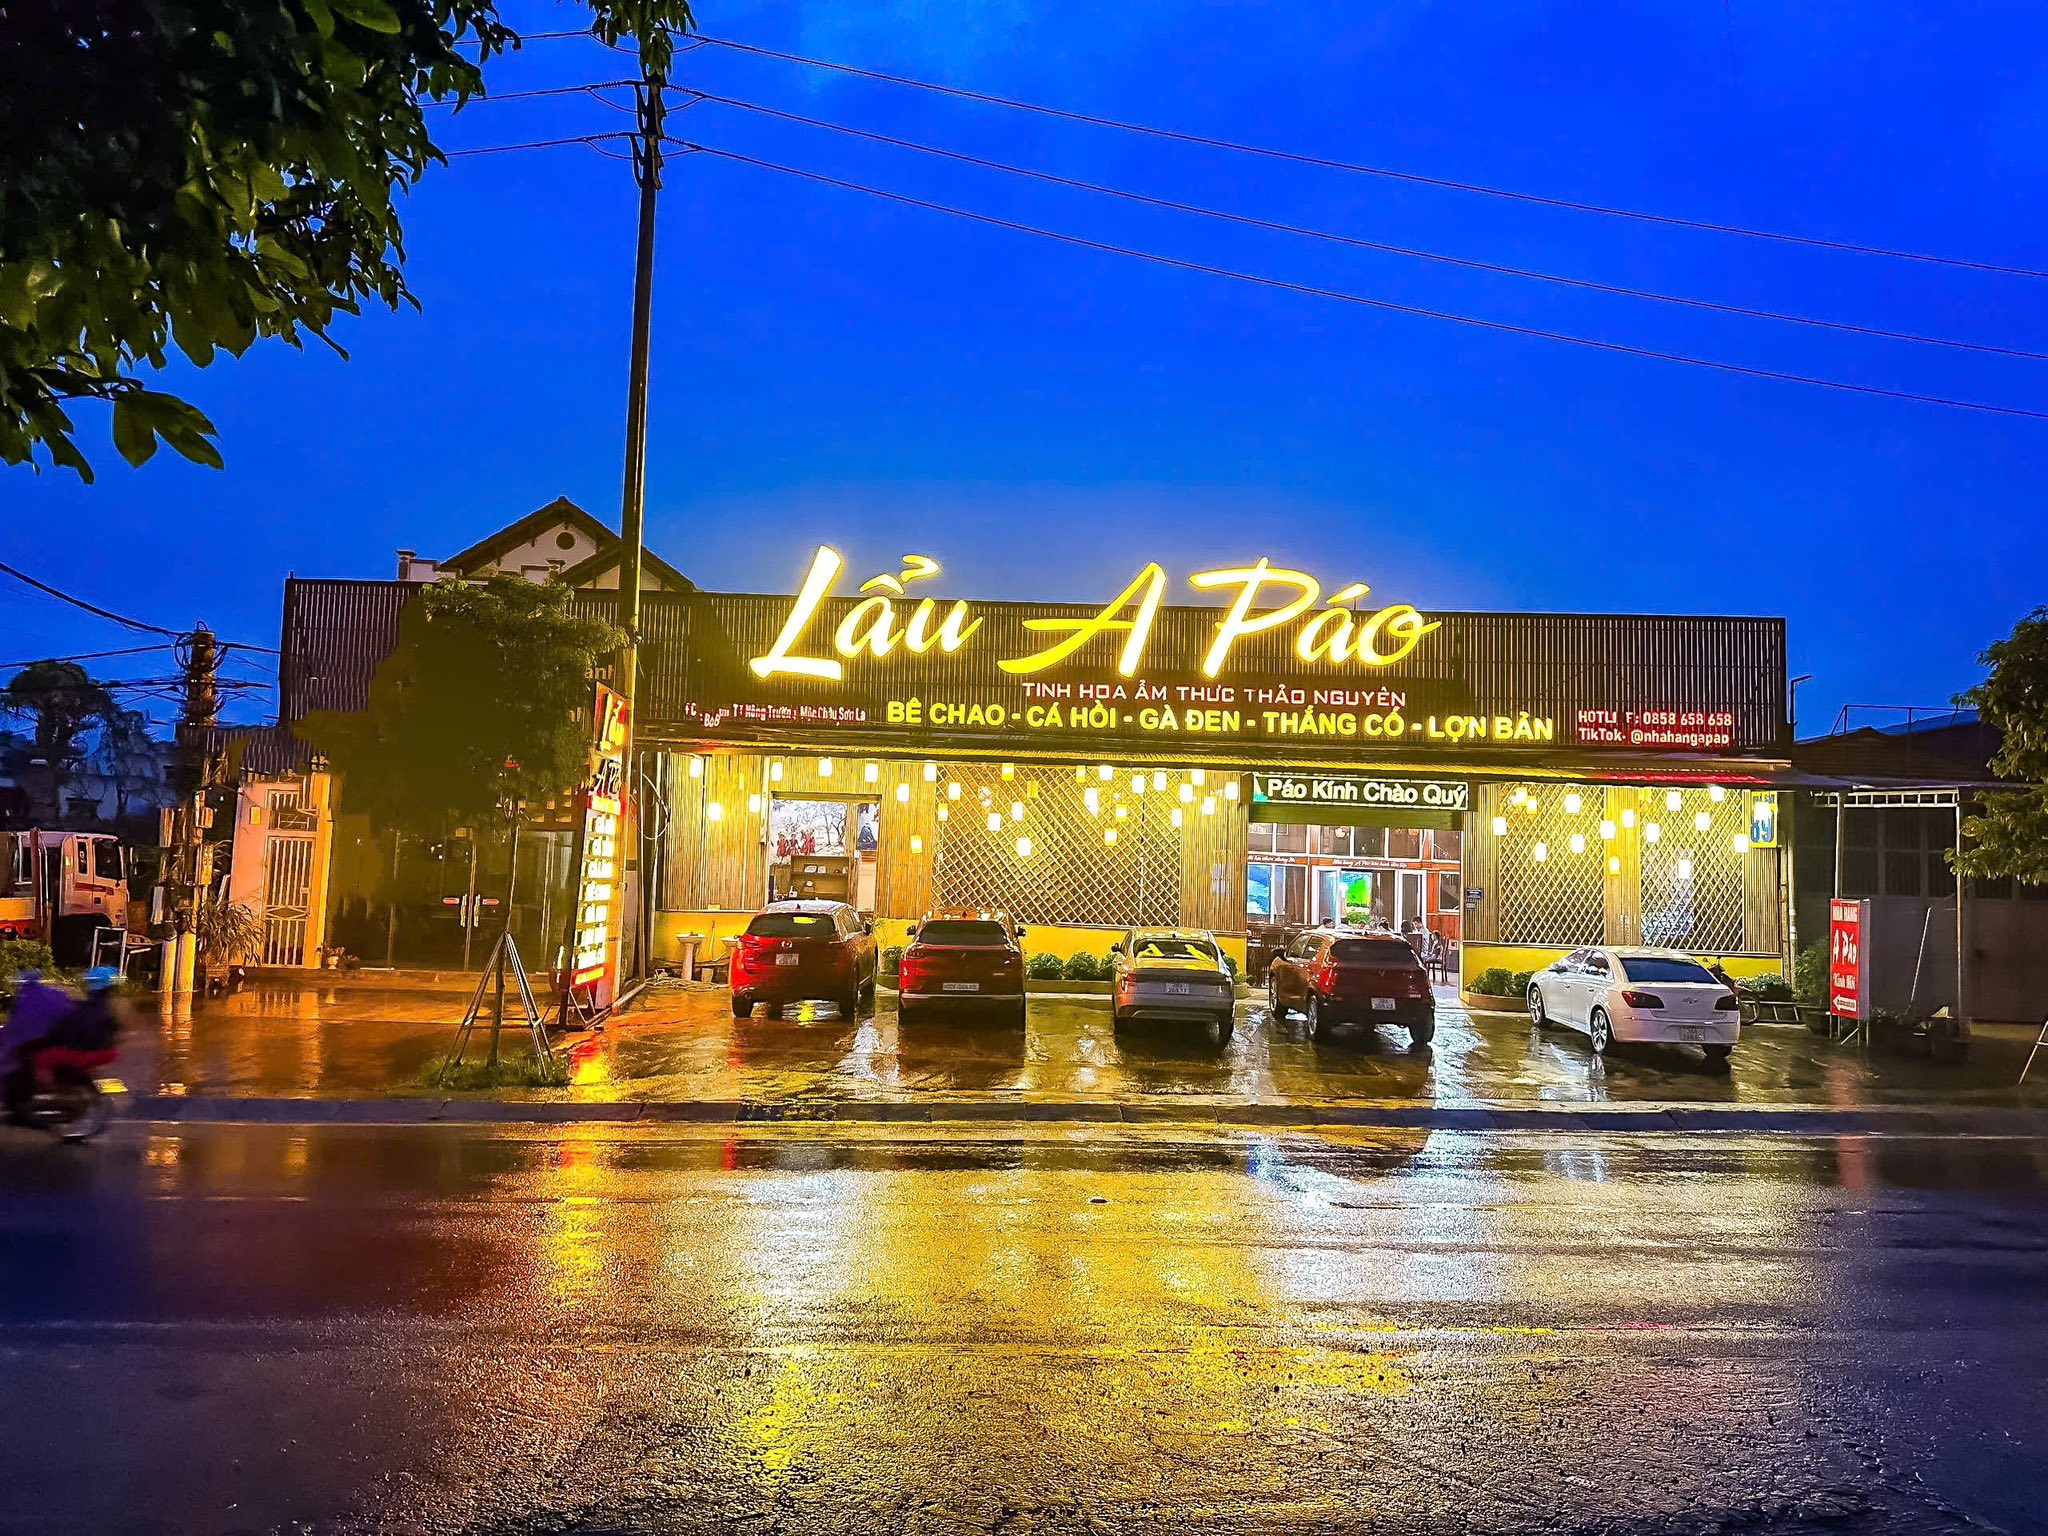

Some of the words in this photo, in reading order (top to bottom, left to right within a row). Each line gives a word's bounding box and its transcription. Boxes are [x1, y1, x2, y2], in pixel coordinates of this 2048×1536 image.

[750, 545, 984, 681] Lẩu
[997, 562, 1167, 678] A
[1188, 556, 1442, 679] Páo
[1022, 682, 1071, 698] TINH
[1079, 684, 1127, 700] HOA
[1243, 683, 1306, 704] THẢO
[1313, 685, 1406, 708] NGUYÊN
[855, 707, 866, 721] La
[887, 697, 922, 724] BÊ
[929, 703, 1006, 726] CHAO
[1027, 703, 1064, 729] CÁ
[1071, 699, 1116, 730] HỒI
[1139, 707, 1179, 731] GÀ
[1186, 710, 1240, 732] ĐEN
[1262, 704, 1356, 735] THẮNG
[1428, 713, 1488, 742] LỢN
[1494, 711, 1553, 741] BẢN
[1643, 711, 1676, 726] 0858
[1680, 712, 1704, 726] 658
[1707, 713, 1732, 727] 658
[1630, 729, 1729, 747] @nhahangapao
[1267, 778, 1307, 801] Páo
[1312, 778, 1358, 801] Kính
[1363, 781, 1418, 804] Chào
[1422, 783, 1468, 809] Quý
[1832, 929, 1840, 964] A
